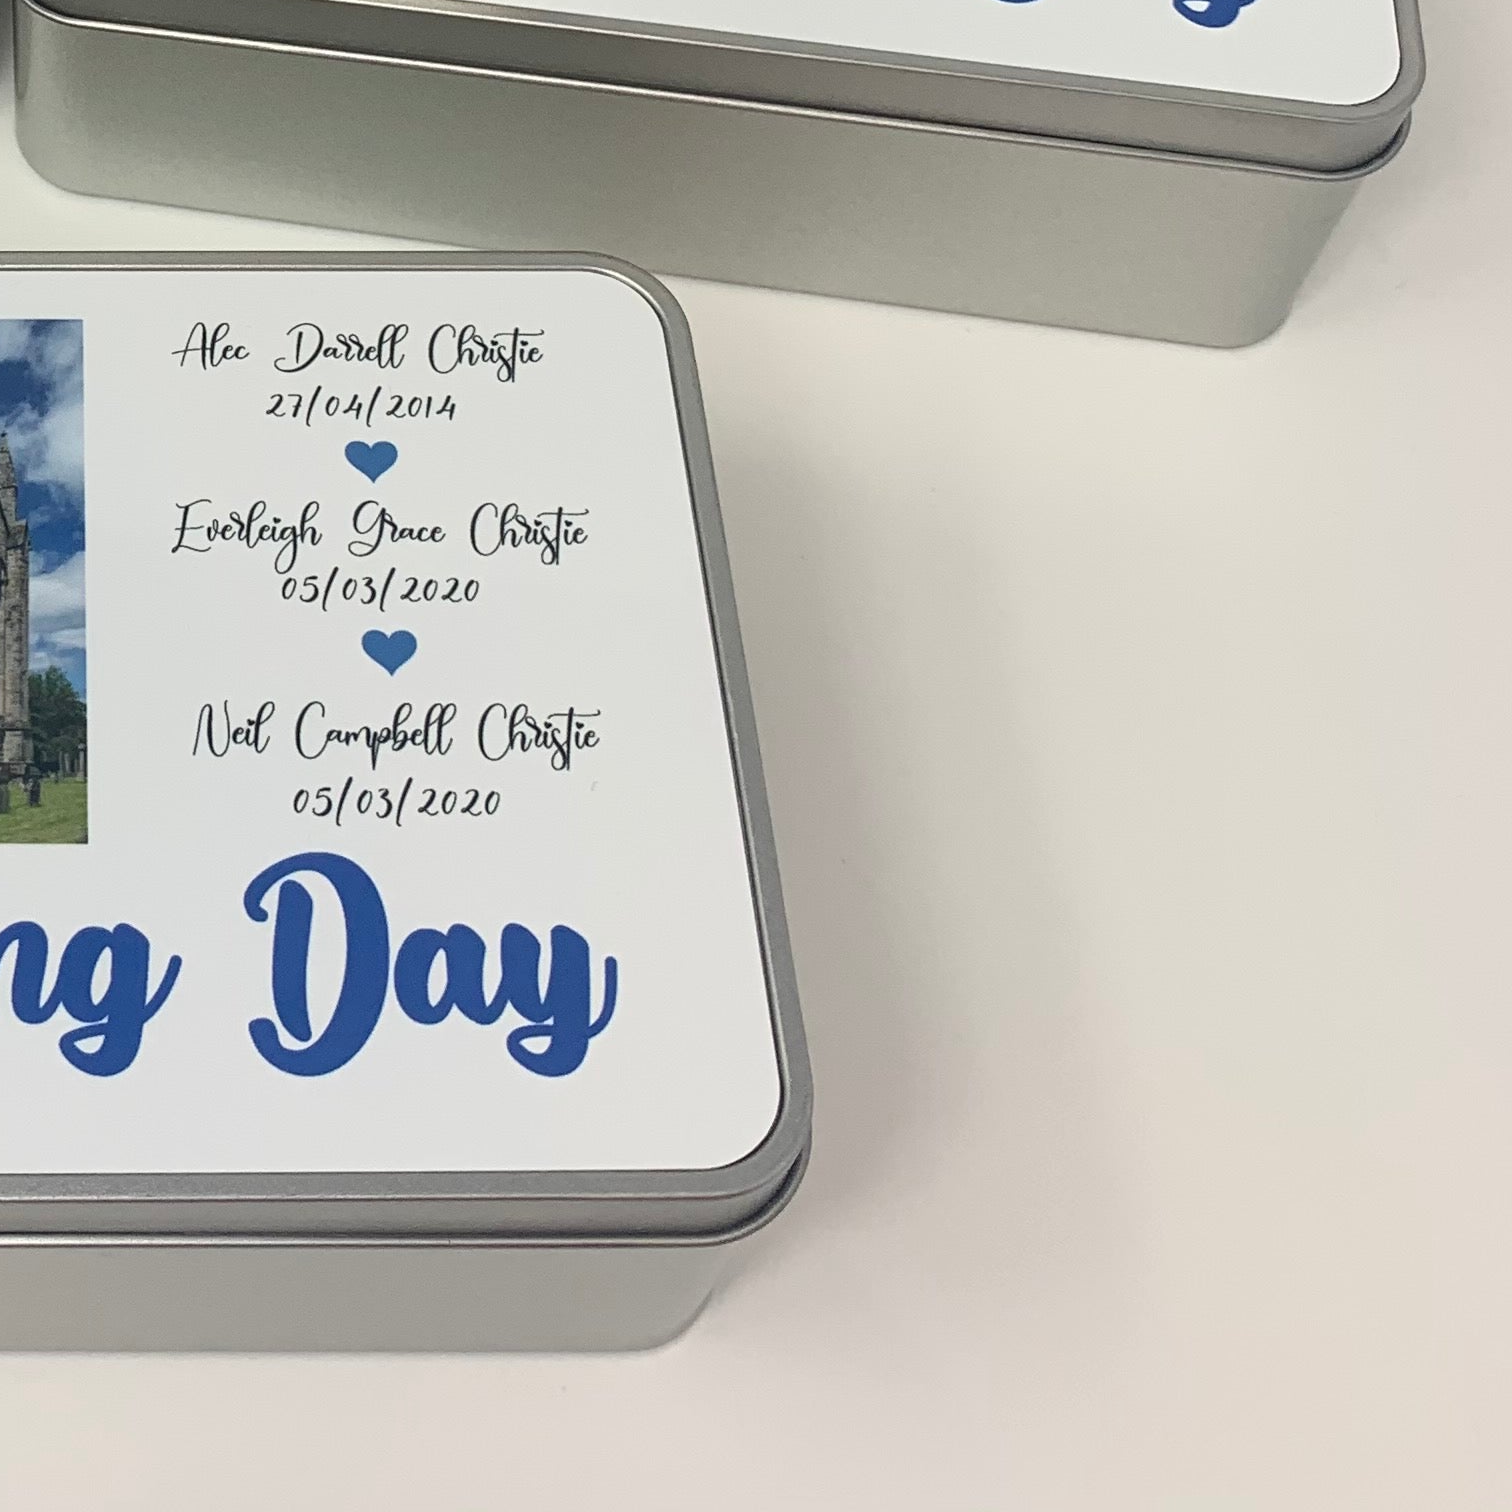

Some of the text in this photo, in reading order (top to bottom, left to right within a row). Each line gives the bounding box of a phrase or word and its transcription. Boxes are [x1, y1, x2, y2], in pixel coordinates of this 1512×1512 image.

[171, 322, 545, 382] Alec Darrell Christie
[265, 386, 456, 427] 27/04/2014
[171, 499, 589, 574] Everleigh Grace Christie
[281, 567, 481, 612] 05/03/2020
[192, 700, 601, 771] Neil Campbell Christie
[293, 776, 502, 827] 05/03/2020
[242, 850, 619, 1078] Day
